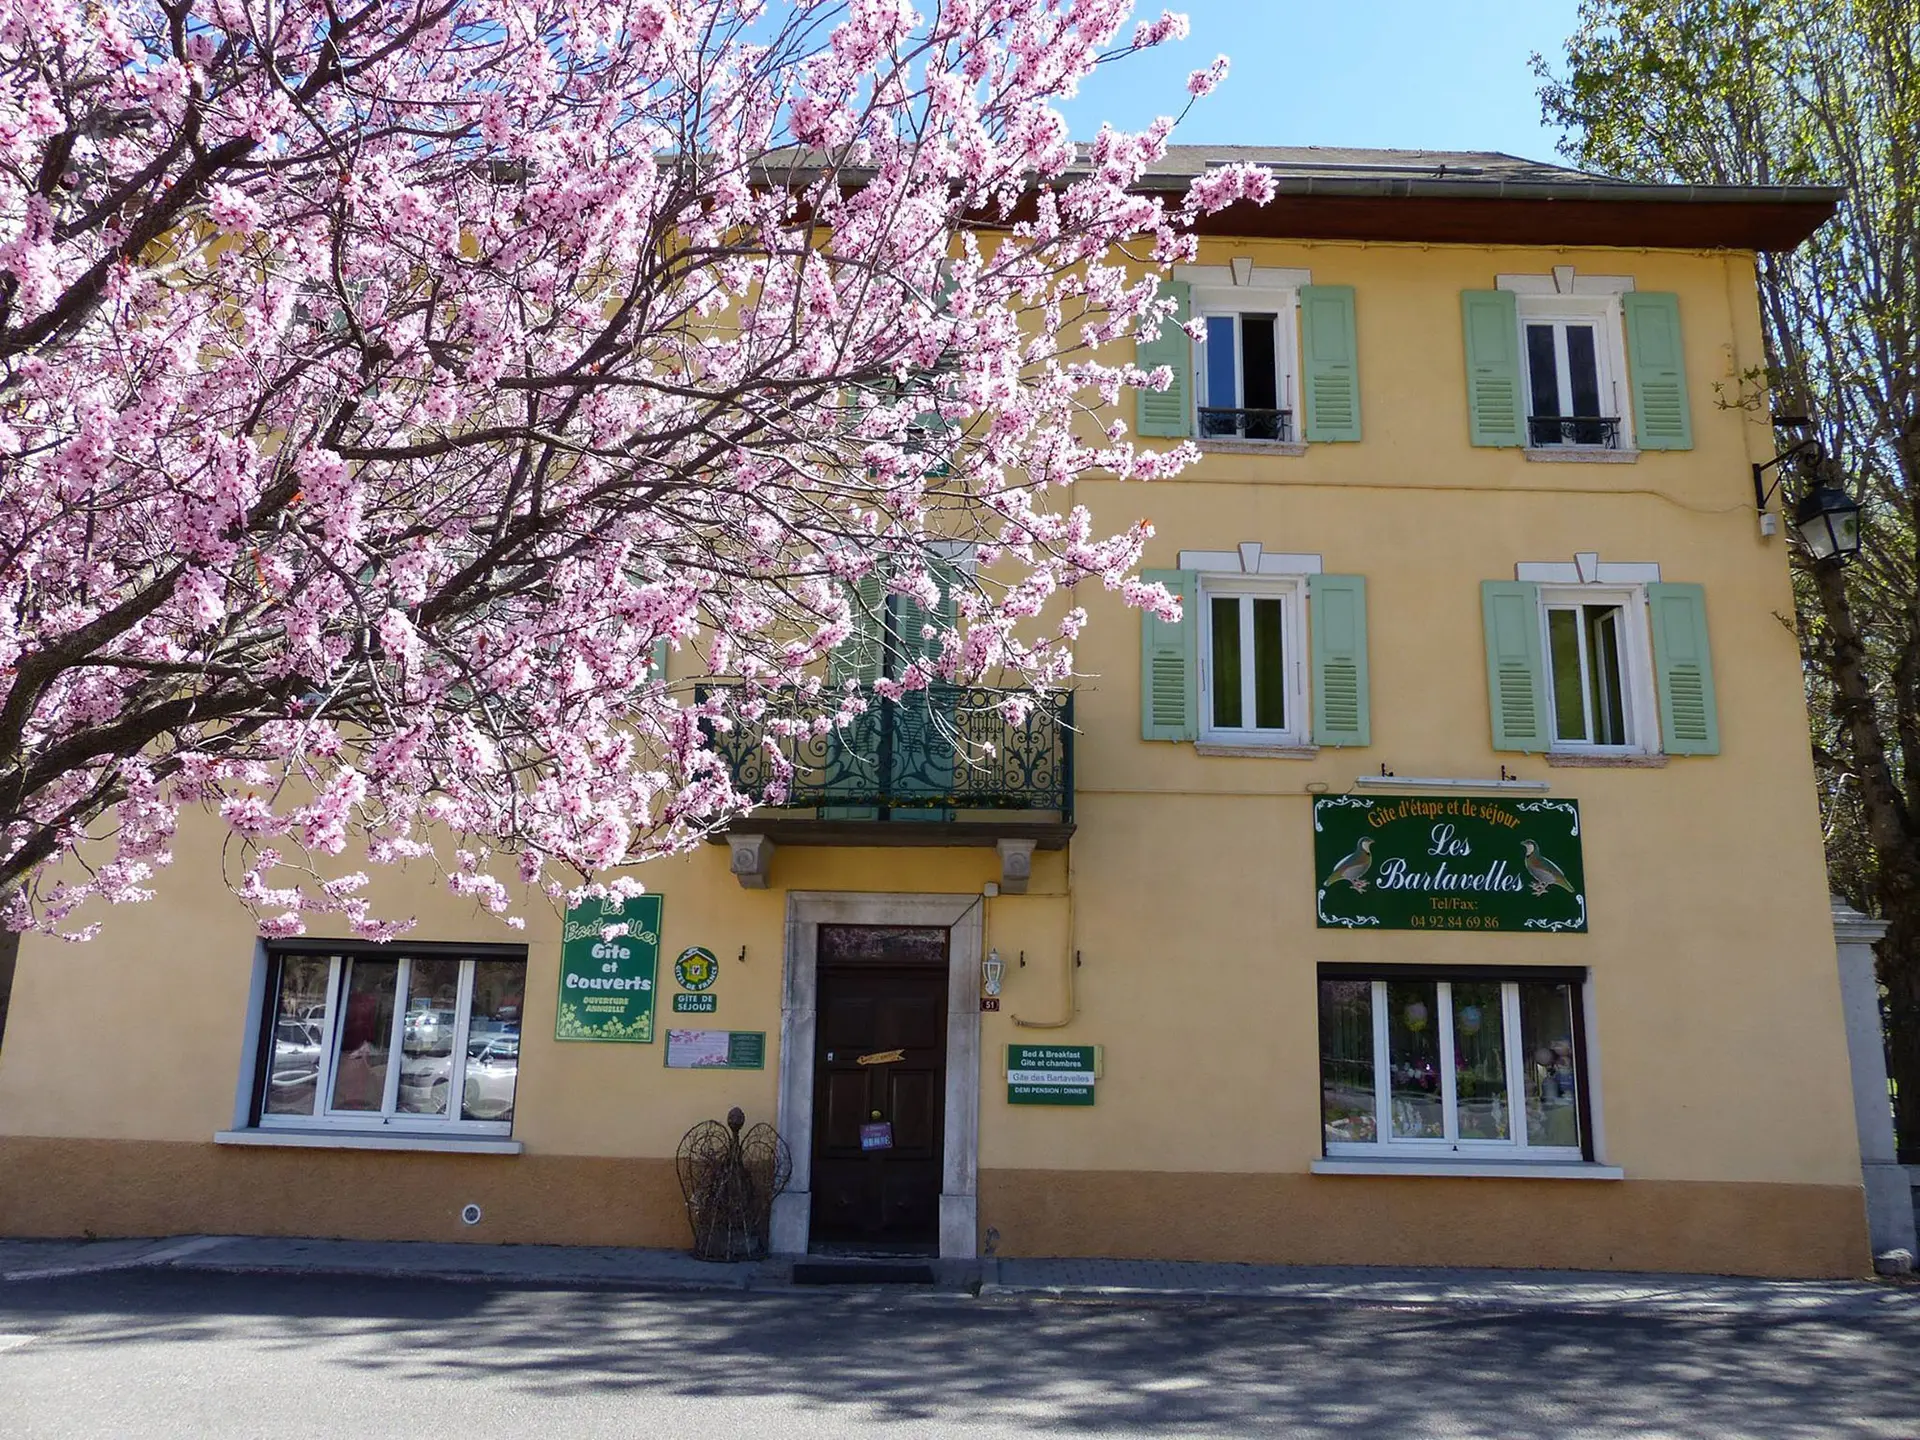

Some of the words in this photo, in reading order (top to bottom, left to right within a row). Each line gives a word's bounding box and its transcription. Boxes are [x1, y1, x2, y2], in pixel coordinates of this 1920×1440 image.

[1367, 807, 1397, 828] Gîte
[1399, 799, 1444, 819] d'étape
[1447, 800, 1459, 815] et
[1462, 799, 1477, 816] de
[1479, 802, 1520, 829] séjour
[1427, 823, 1473, 856] Les
[1376, 857, 1524, 892] Bartavelles
[1430, 897, 1478, 910] Tel/Fax:
[1411, 915, 1425, 928] 04
[1429, 915, 1444, 928] 92
[1447, 915, 1462, 928] 84
[1466, 915, 1481, 928] 69
[1484, 915, 1499, 928] 86
[564, 917, 657, 945] Bartlles
[591, 943, 631, 959] Gîte
[602, 962, 618, 973] et
[566, 973, 651, 991] Couverts
[985, 1001, 994, 1009] 51
[1022, 1050, 1037, 1058] Bed
[1038, 1050, 1044, 1058] &
[1046, 1050, 1081, 1059] Breakfast
[1037, 1059, 1045, 1067] et
[1046, 1059, 1082, 1068] chambres
[1030, 1073, 1045, 1082] des
[1063, 1087, 1088, 1095] DINNER
